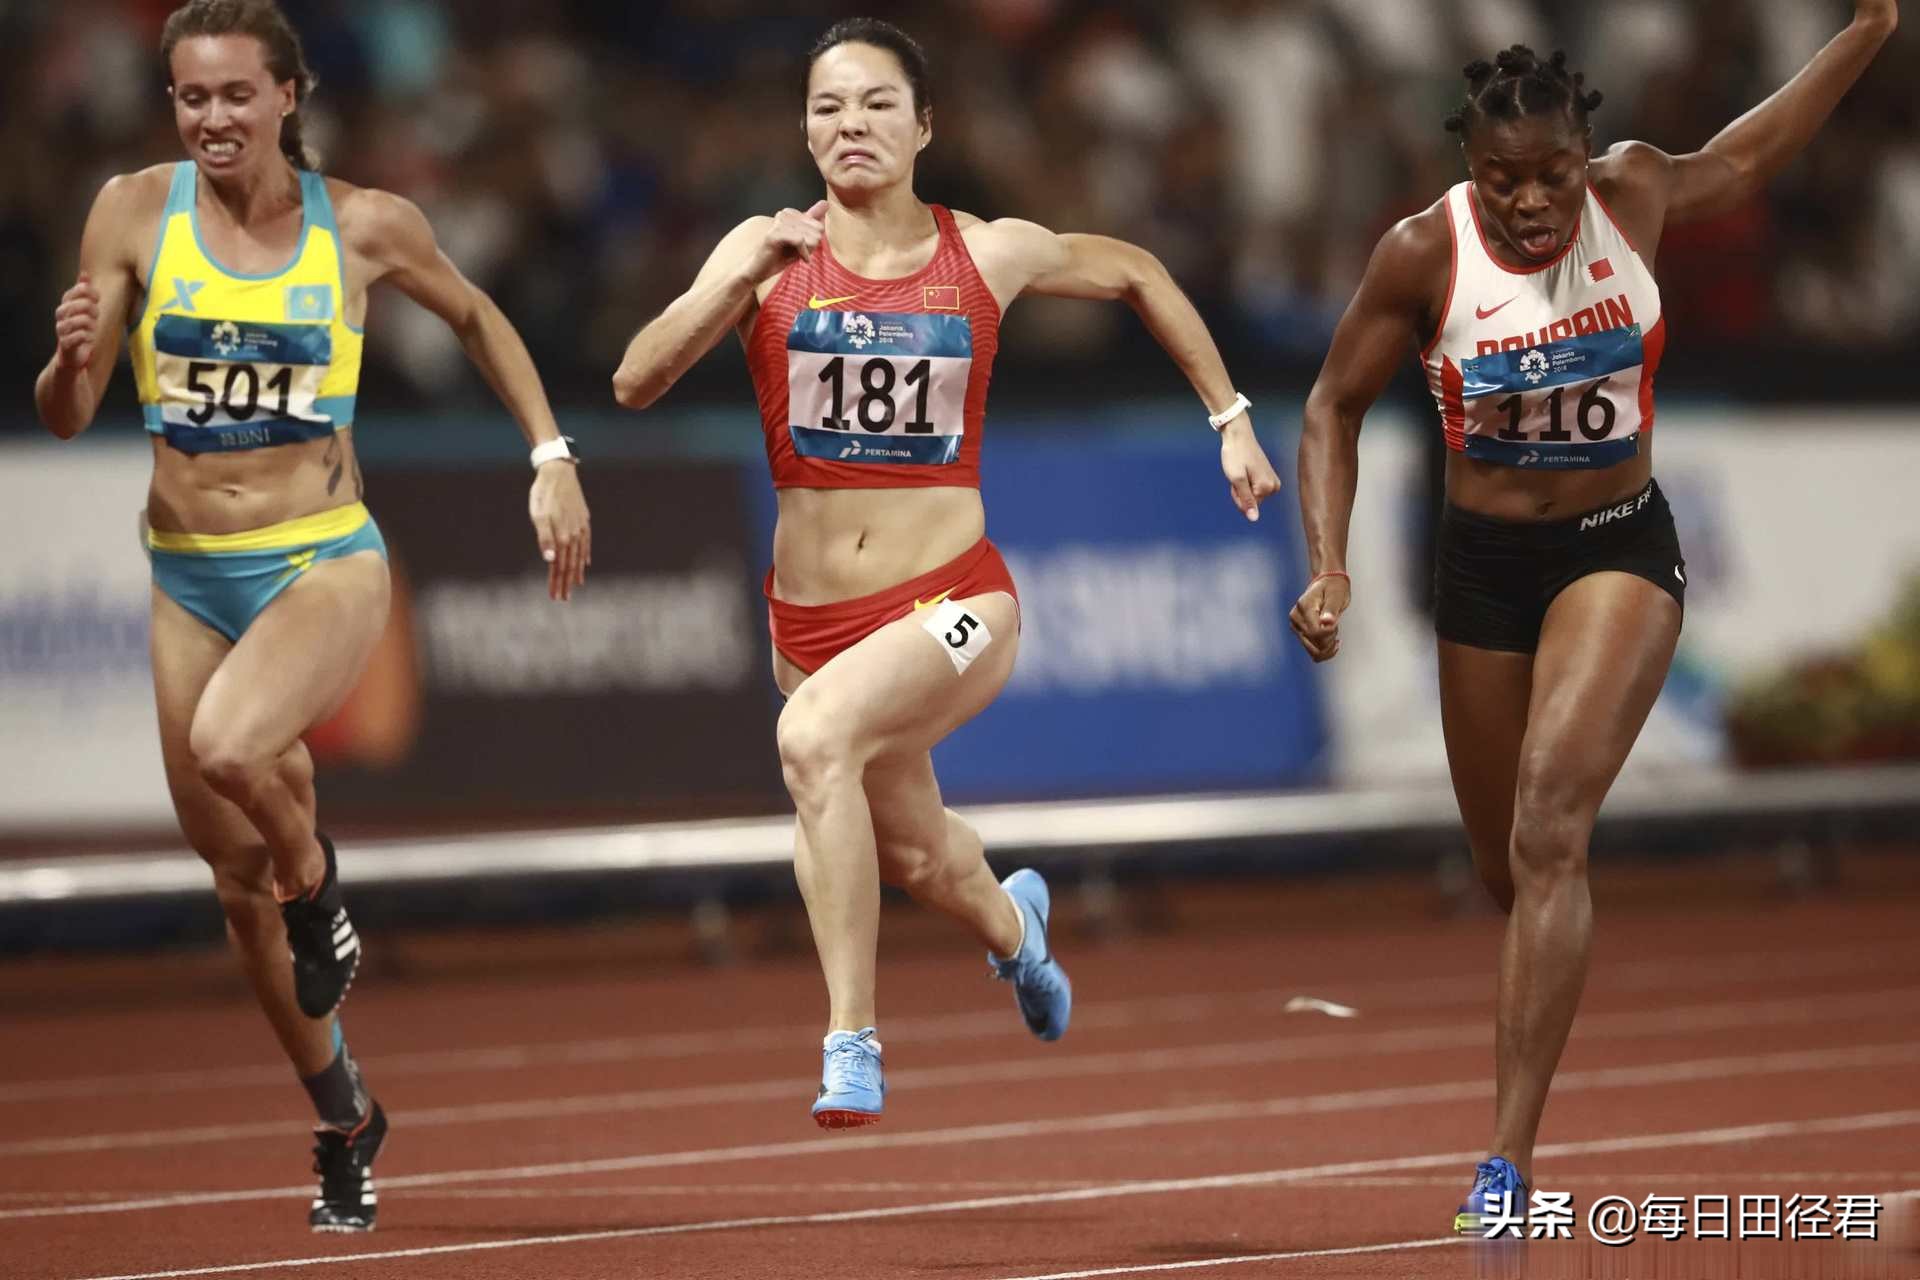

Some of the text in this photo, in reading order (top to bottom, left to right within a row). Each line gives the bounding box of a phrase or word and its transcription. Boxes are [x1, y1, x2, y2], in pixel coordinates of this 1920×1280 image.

[186, 361, 292, 425] 501
[818, 356, 934, 433] 181
[1496, 376, 1616, 441] 116
[864, 448, 912, 458] PERTAMINA
[1580, 500, 1634, 532] NIKE
[944, 612, 979, 649] 5
